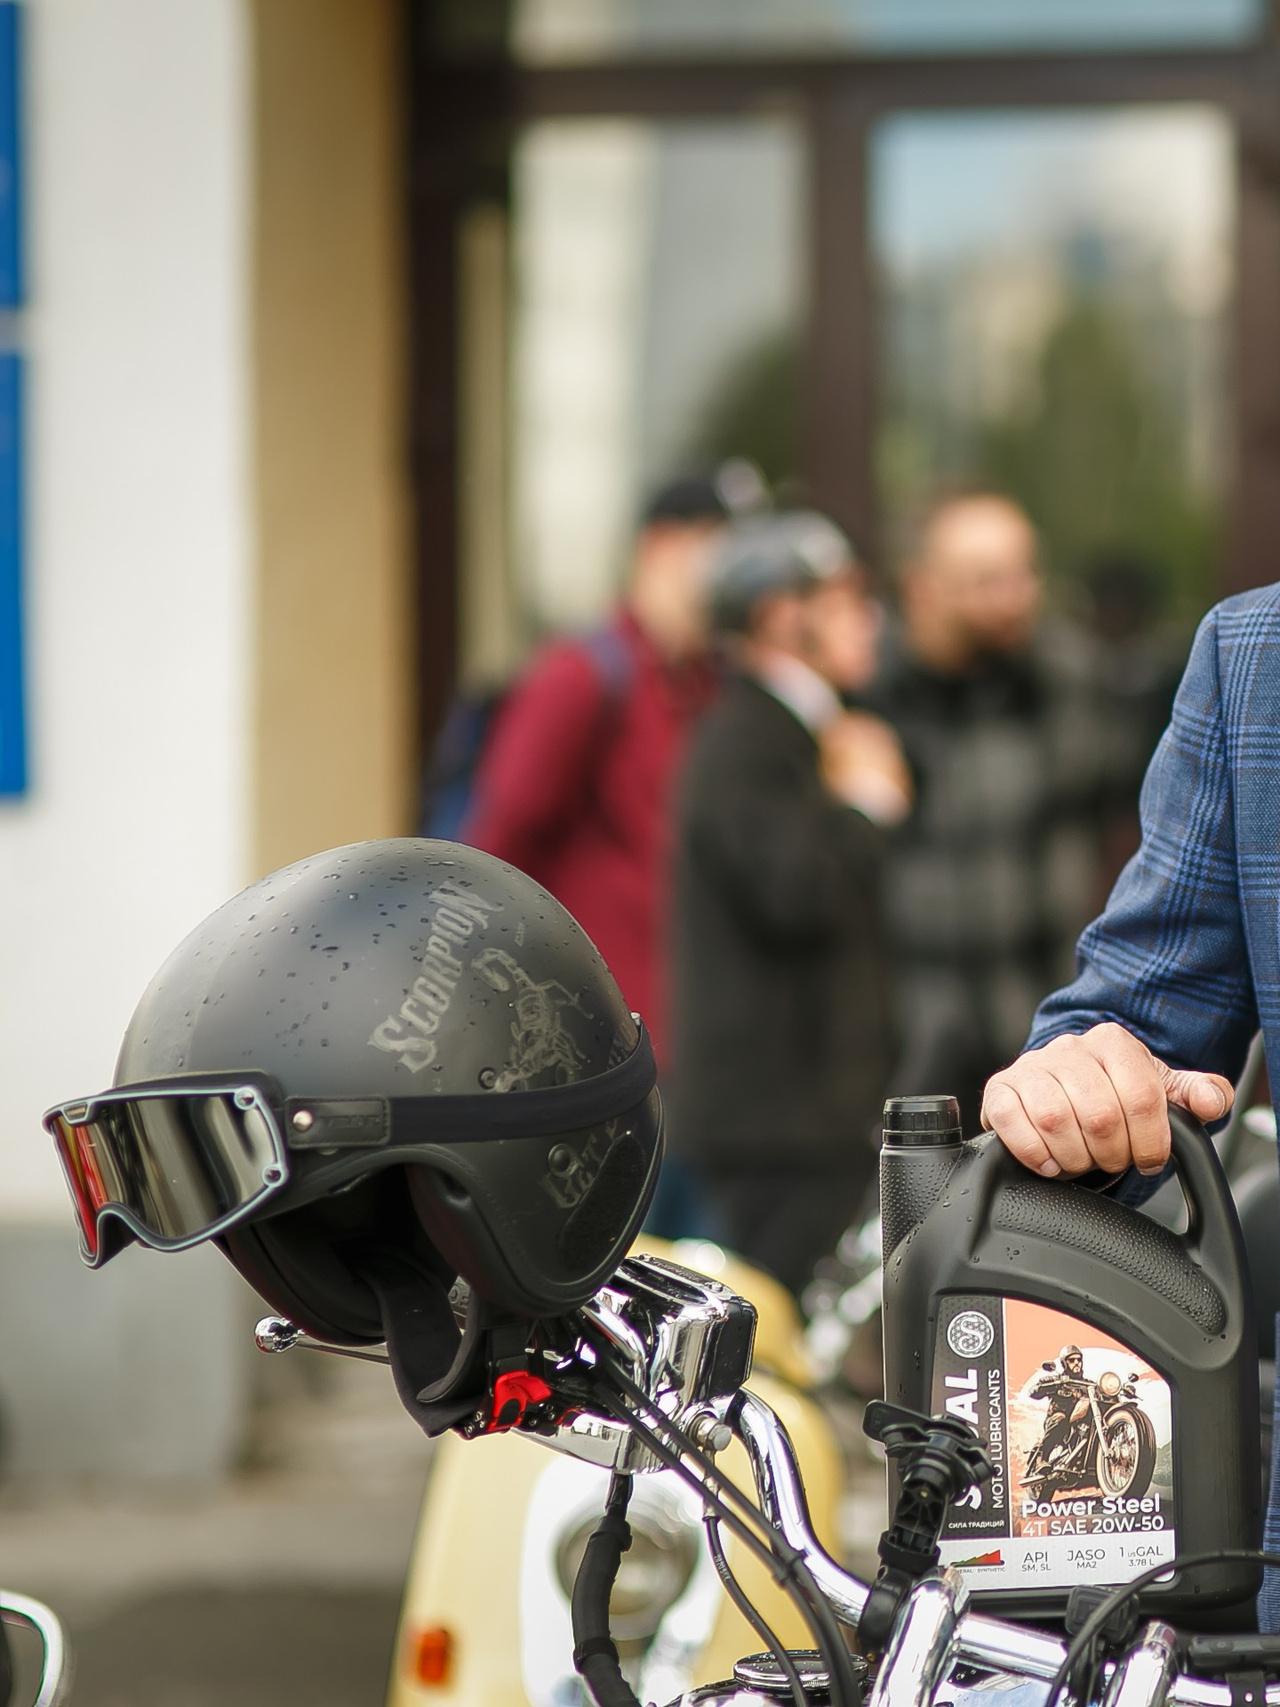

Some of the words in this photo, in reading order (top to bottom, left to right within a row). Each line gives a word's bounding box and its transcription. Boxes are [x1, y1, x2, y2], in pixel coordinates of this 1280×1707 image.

[988, 1368, 1004, 1461] LUBRICANTS
[1021, 1498, 1096, 1519] Power
[1101, 1494, 1161, 1515] Steel
[948, 1521, 968, 1529] СИЛА
[968, 1519, 1005, 1529] ТРАДИЦИЙ
[1022, 1521, 1045, 1537] 4T
[1050, 1518, 1087, 1536] SAE
[1092, 1514, 1165, 1534] 20W-50
[1023, 1551, 1048, 1563] API
[1067, 1548, 1106, 1562] JASO
[1119, 1546, 1124, 1558] 1
[1021, 1563, 1038, 1573] SM,
[1040, 1563, 1052, 1572] SL
[1077, 1561, 1097, 1570] MA2
[1128, 1558, 1147, 1567] 3.78
[1149, 1558, 1155, 1567] L
